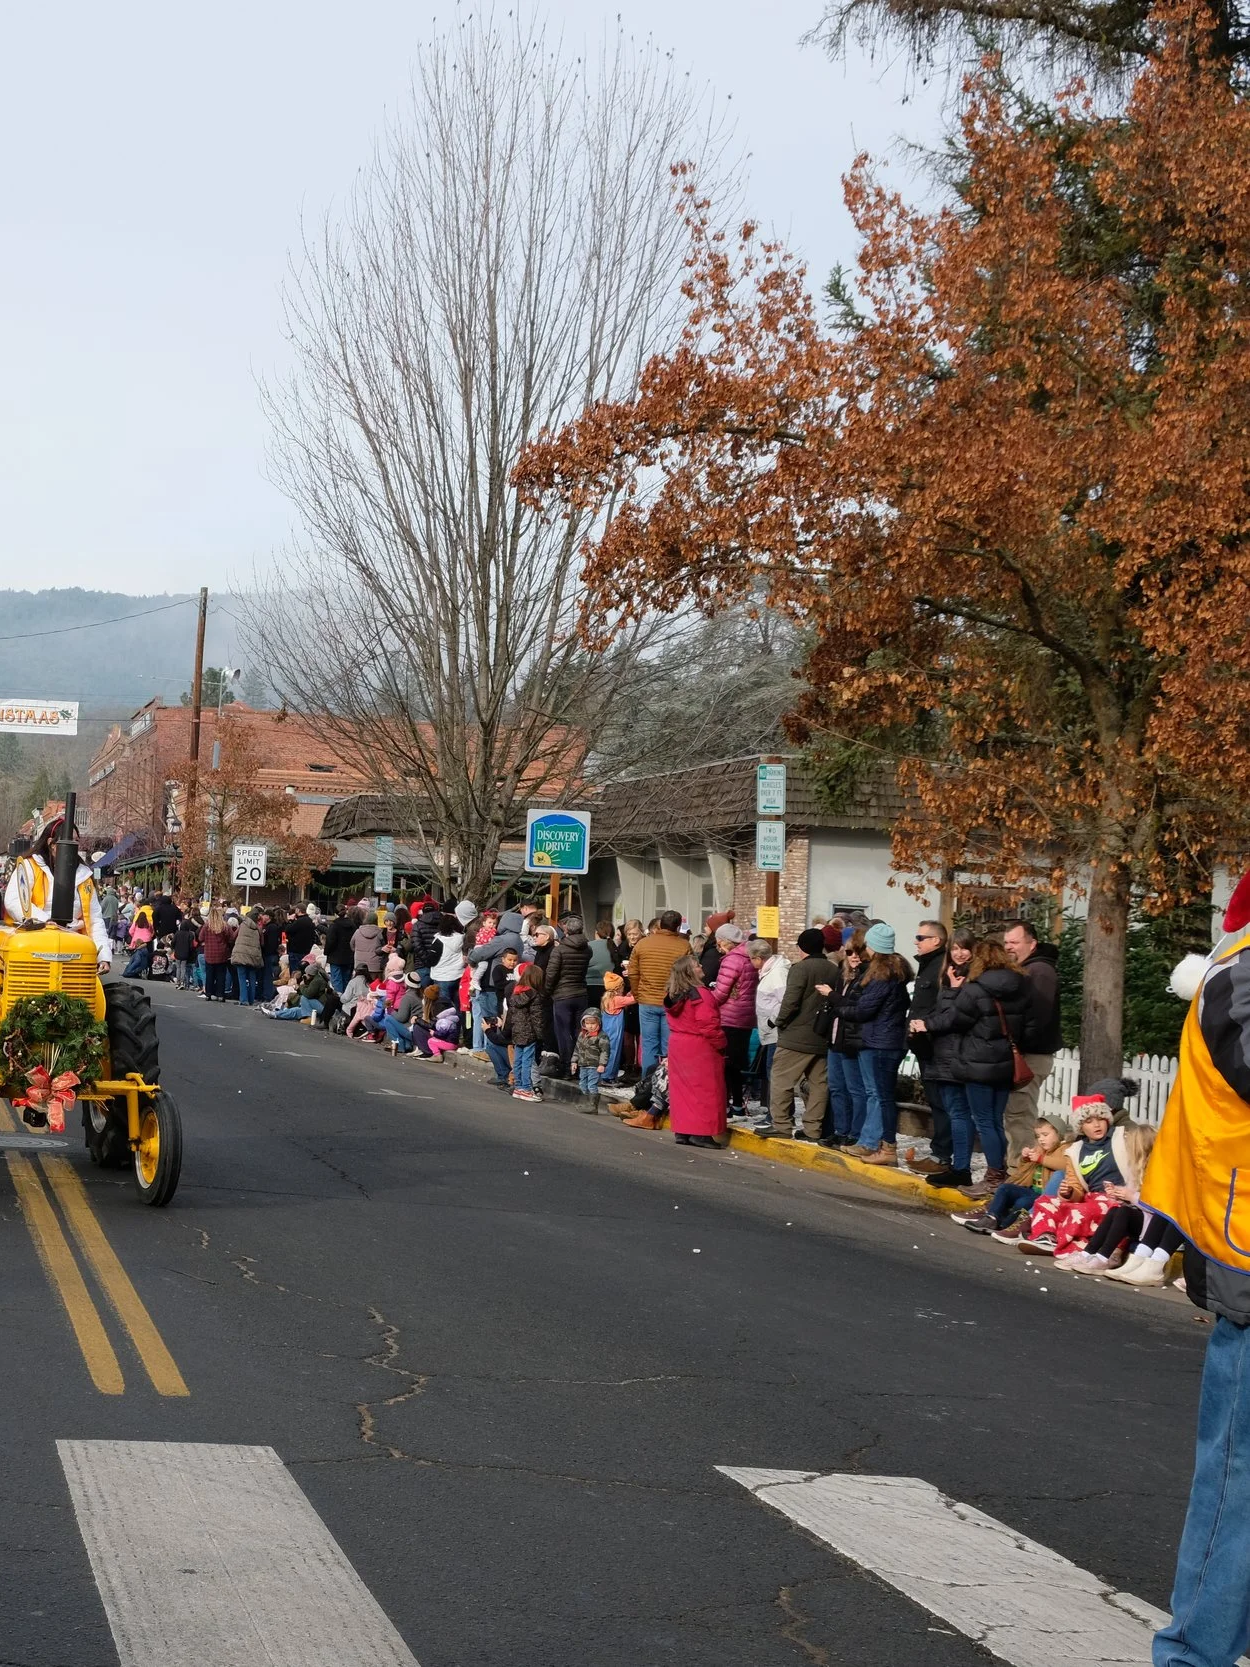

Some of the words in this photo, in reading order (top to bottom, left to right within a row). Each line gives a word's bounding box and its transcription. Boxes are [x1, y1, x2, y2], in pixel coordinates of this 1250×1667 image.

[537, 829, 580, 842] DISCOVERY
[545, 841, 572, 852] DRIVE
[760, 844, 781, 852] PARKING
[236, 849, 264, 857] SPEED
[236, 866, 262, 881] 20
